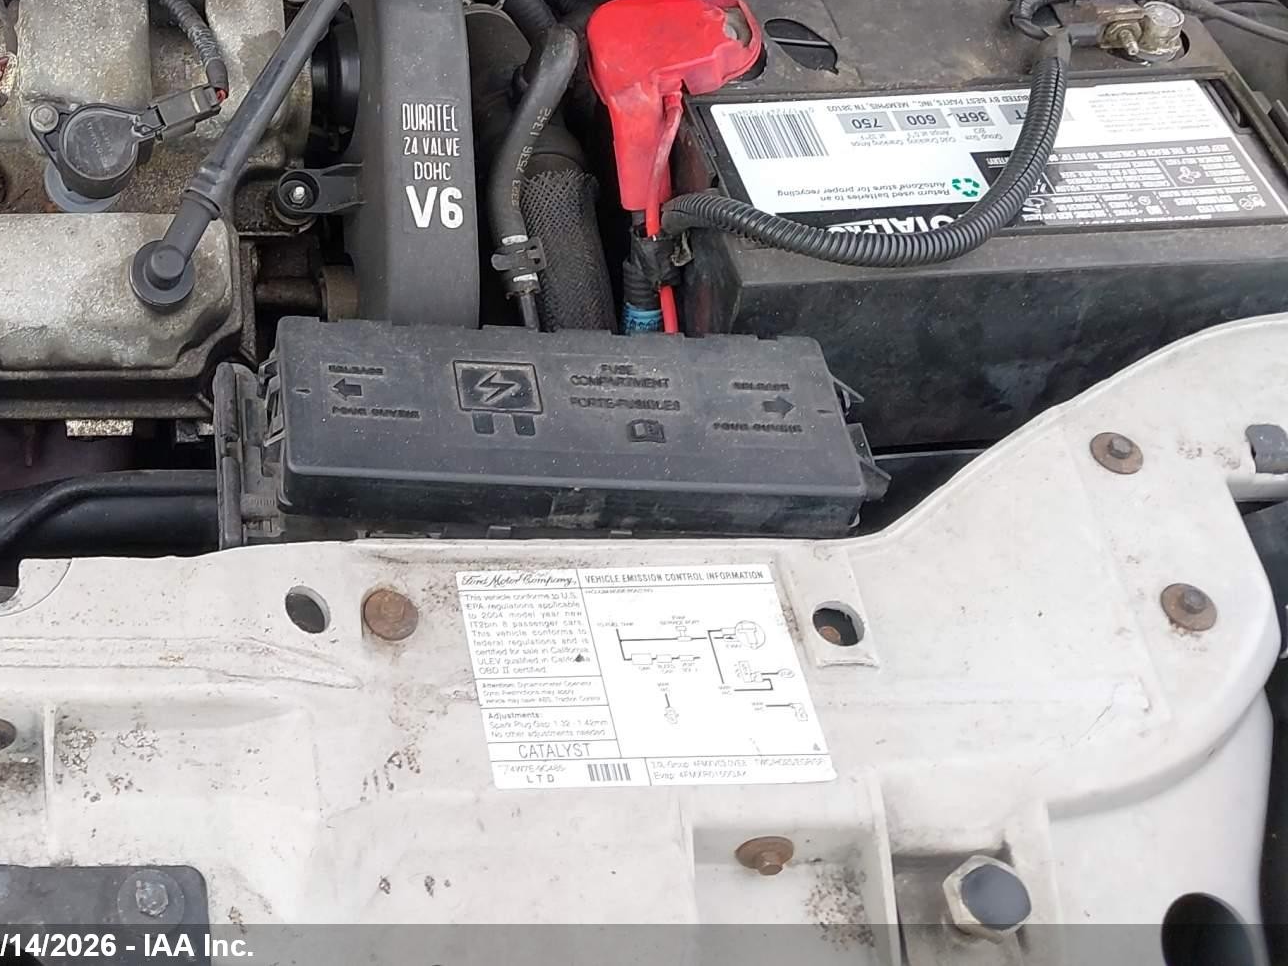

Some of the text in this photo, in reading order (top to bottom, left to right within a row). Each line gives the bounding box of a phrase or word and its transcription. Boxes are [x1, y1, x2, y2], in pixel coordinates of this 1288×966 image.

[851, 118, 882, 129] 750
[906, 114, 937, 125] 600
[403, 136, 461, 157] 24 VALVE
[413, 161, 451, 181] DOHC
[777, 189, 820, 197] recycling
[823, 186, 854, 194] proper
[847, 193, 890, 201] batteries
[405, 185, 464, 229] V6
[570, 375, 669, 388] COMPARTMENT
[462, 575, 489, 586] Ford
[487, 574, 520, 587] Motor
[584, 570, 765, 584] VEHICLE EMISSION CONTROL INFORMATION
[488, 602, 534, 611] regulations
[538, 601, 581, 609] applicable
[542, 611, 559, 619] year
[513, 620, 558, 629] passenger
[508, 638, 557, 647] regulations
[475, 648, 507, 656] certified
[523, 647, 538, 655] sale
[477, 657, 501, 665] ULEV
[504, 656, 538, 665] qualified
[488, 712, 542, 721] Adjustments:
[489, 721, 512, 729] Spark
[514, 720, 532, 729] Plug
[505, 730, 525, 738] other
[528, 730, 574, 738] adjustments
[518, 743, 592, 759] CATALYST
